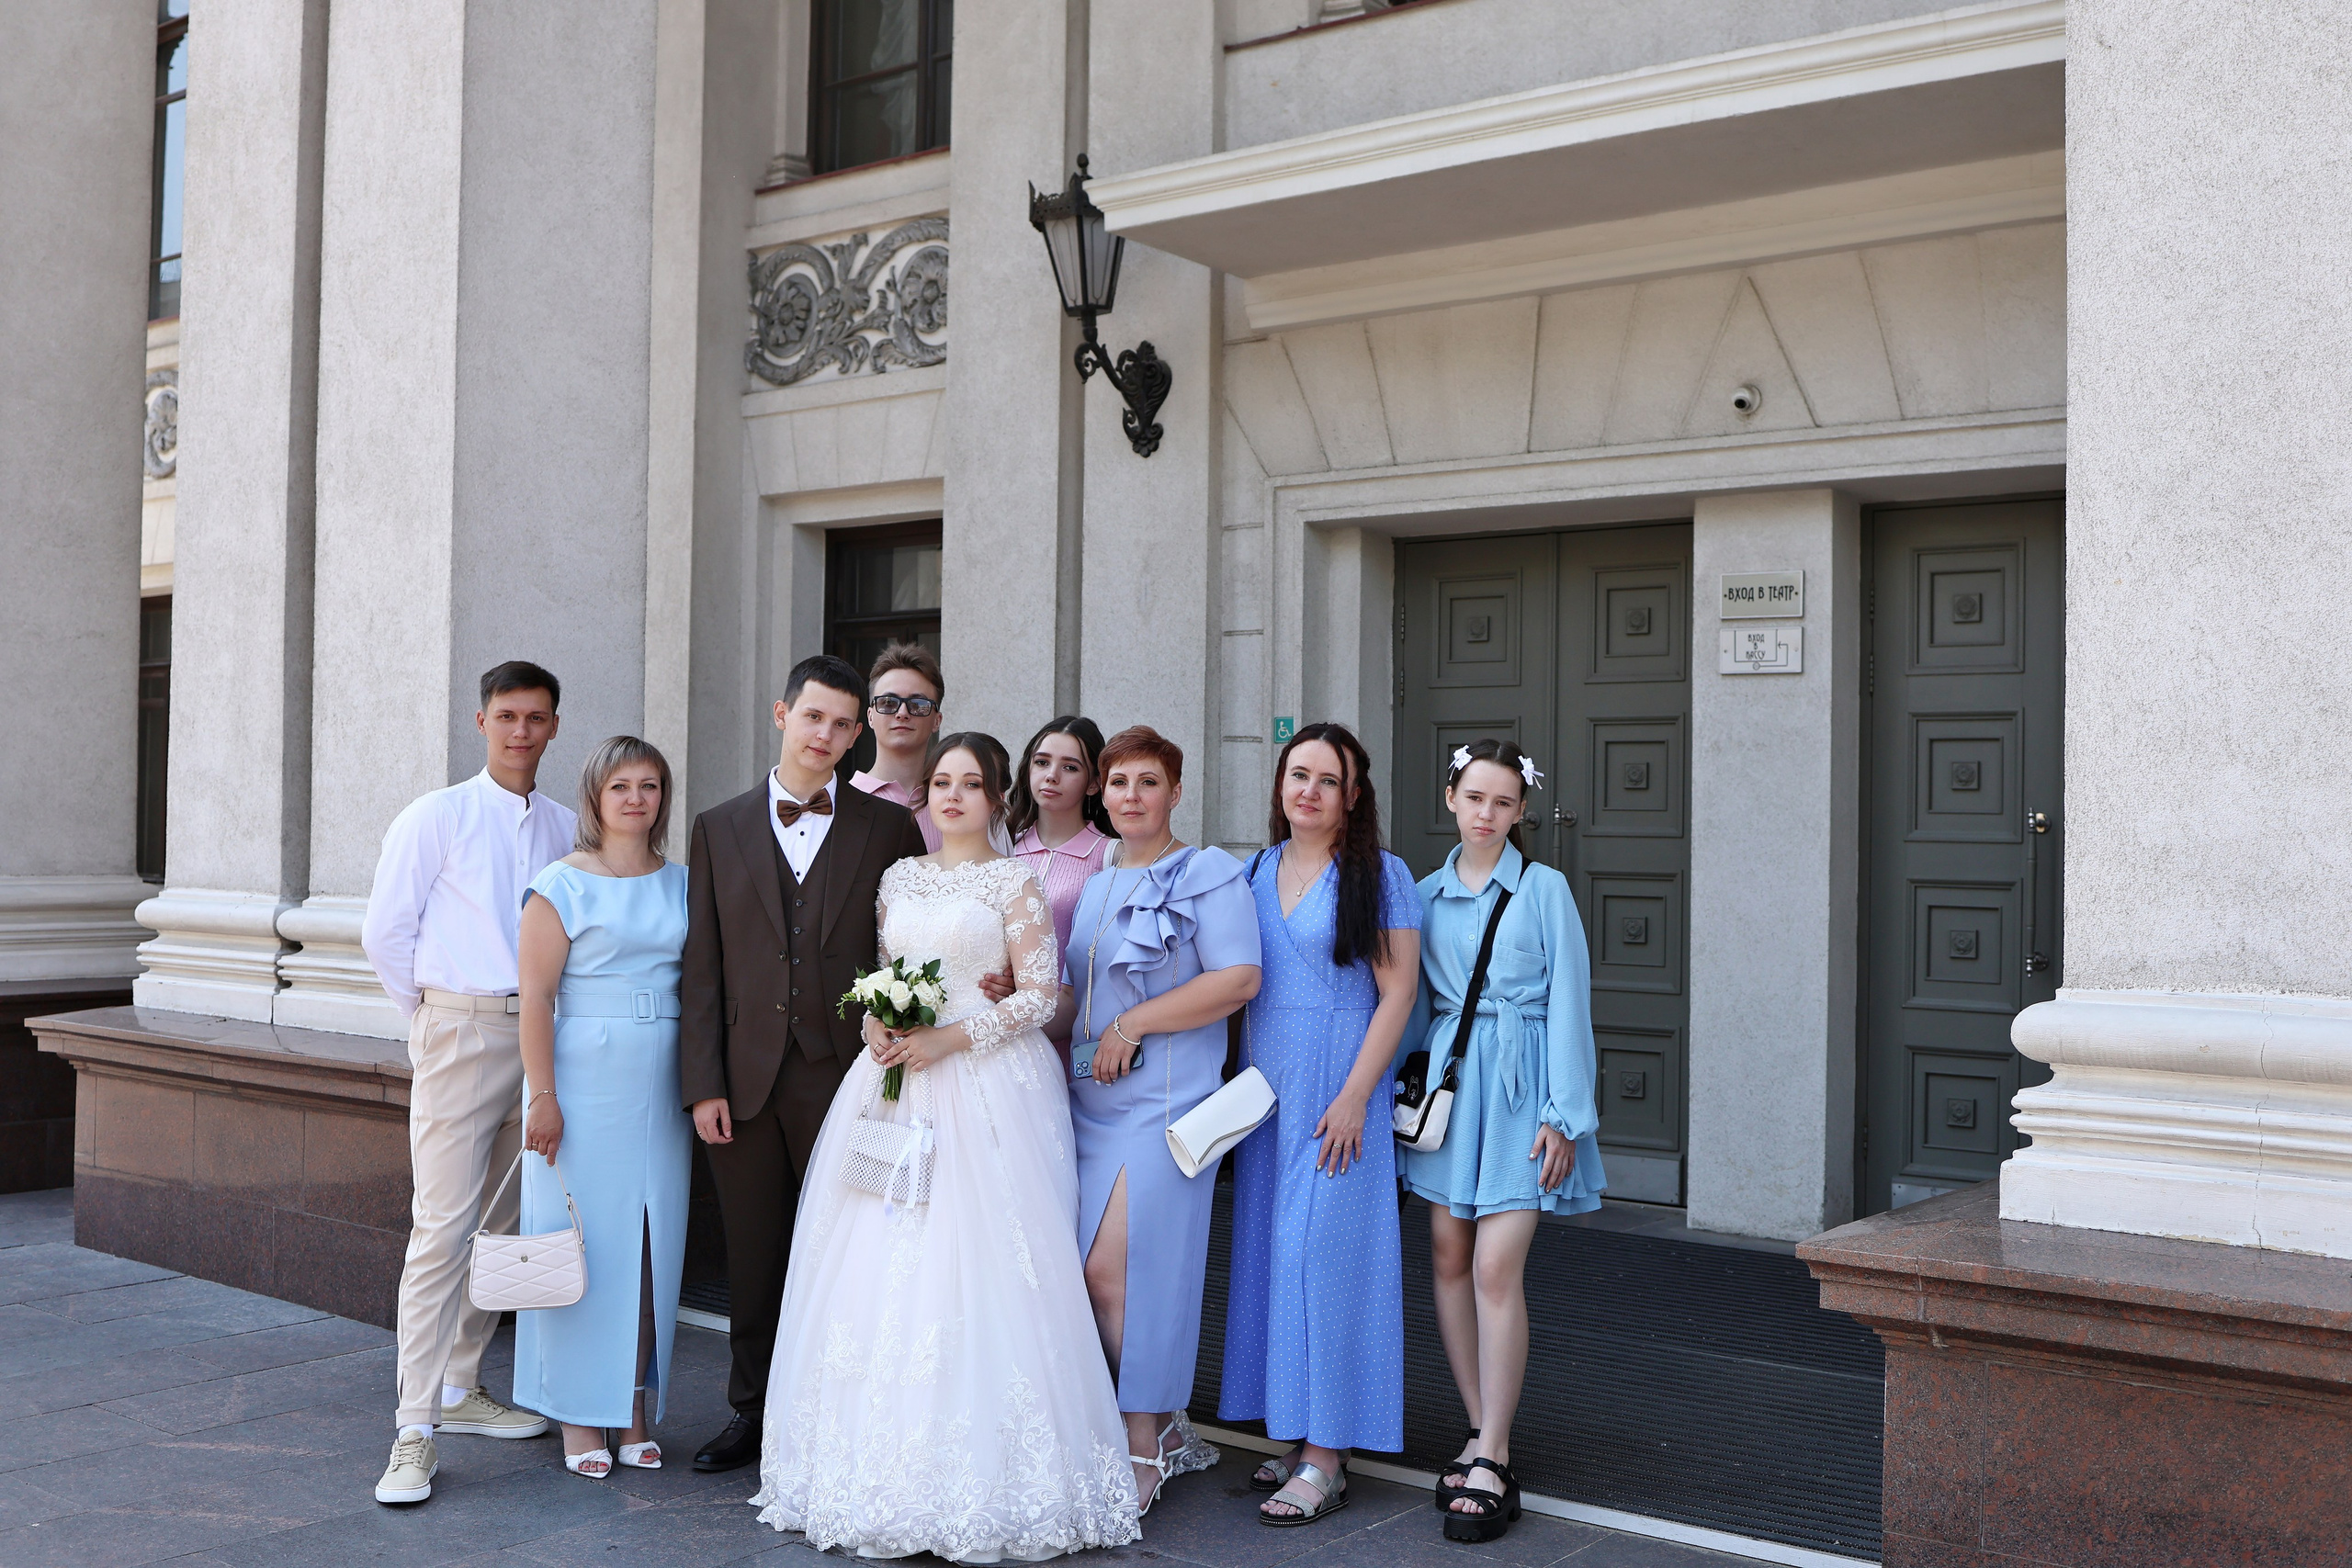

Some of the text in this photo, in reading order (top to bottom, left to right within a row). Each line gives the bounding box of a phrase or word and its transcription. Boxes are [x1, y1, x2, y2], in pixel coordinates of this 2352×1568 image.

[1728, 585, 1795, 603] ВХОД В ТЕАТР
[1747, 634, 1765, 644] ВХОД
[1754, 642, 1758, 650] В
